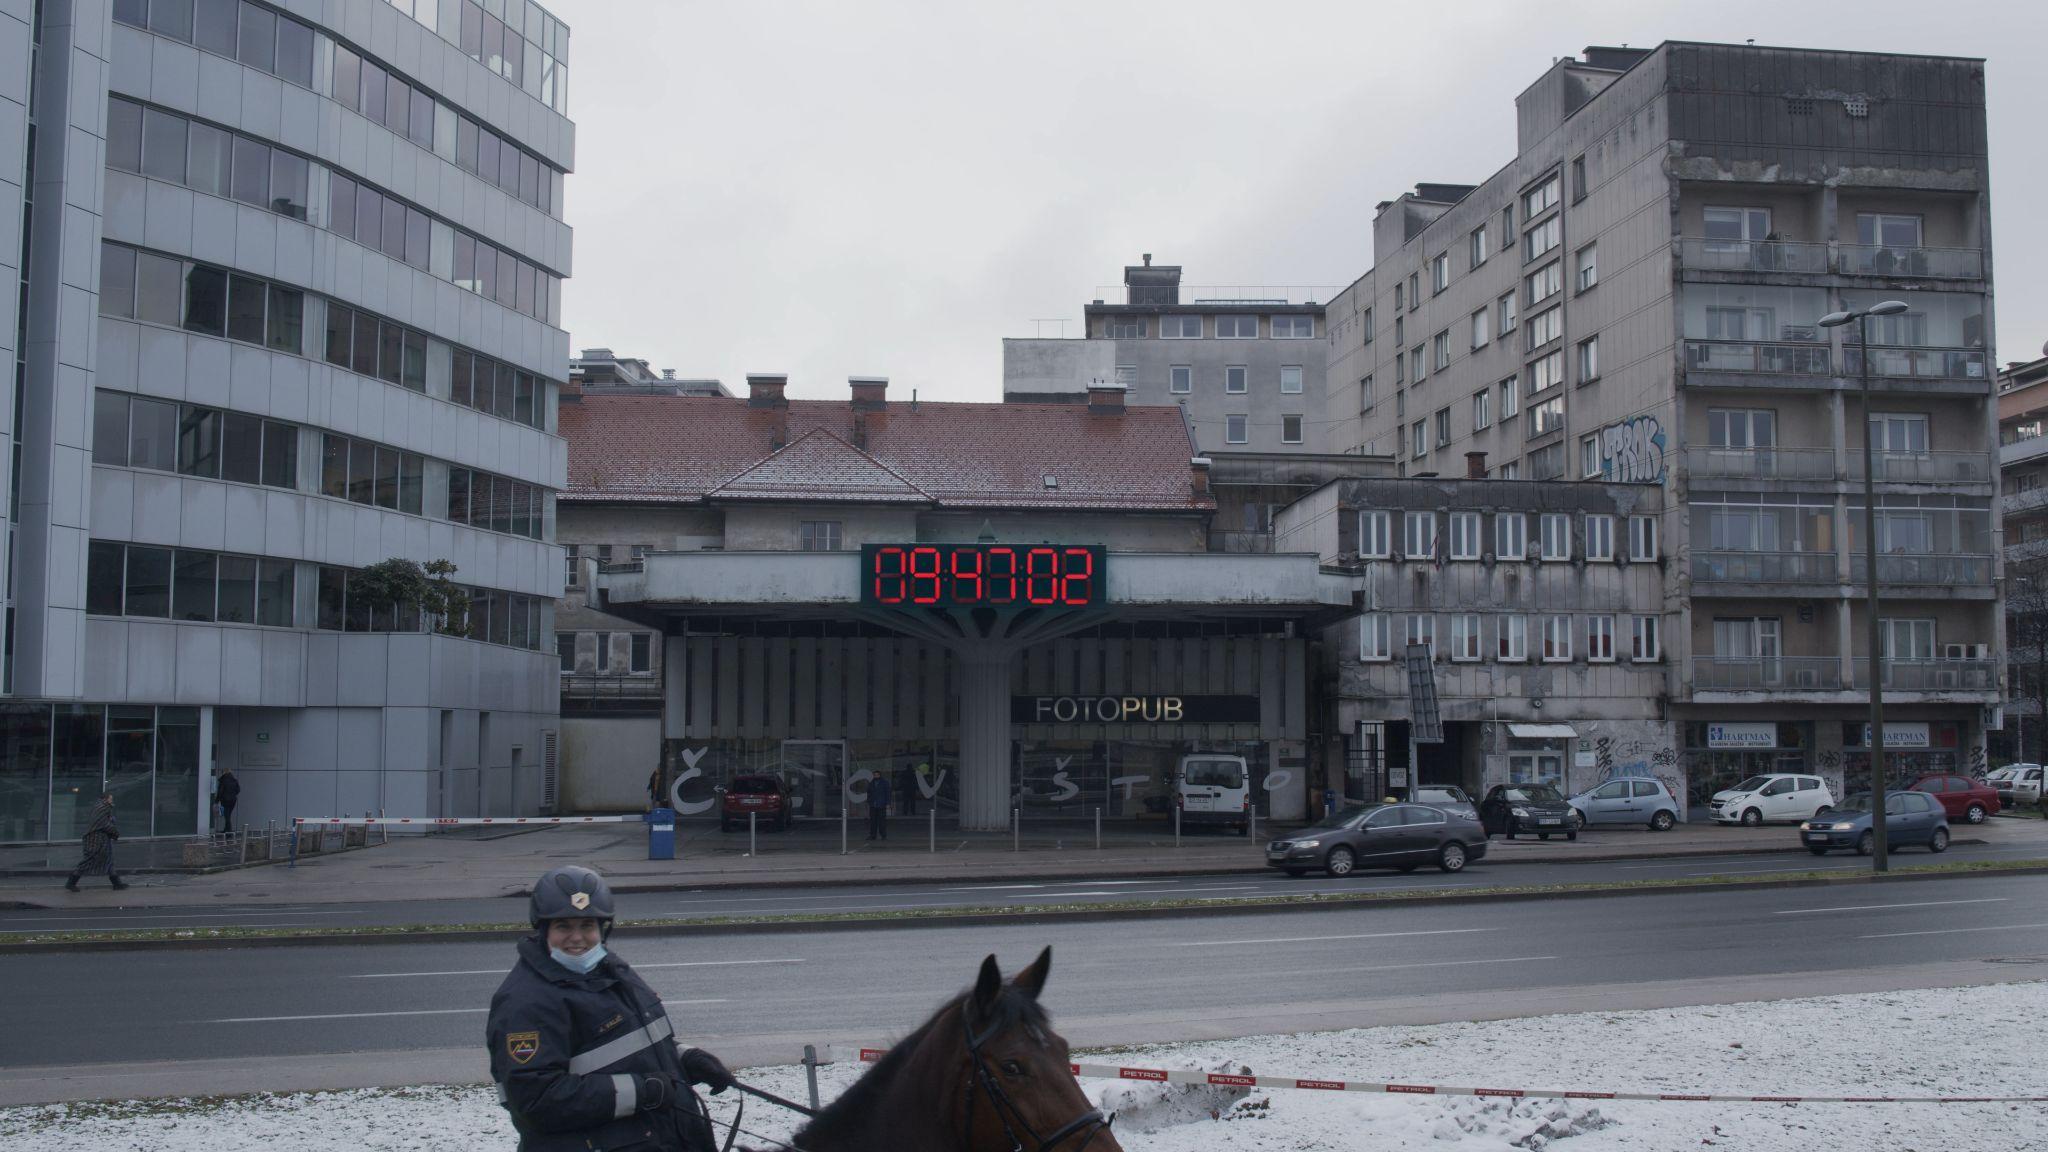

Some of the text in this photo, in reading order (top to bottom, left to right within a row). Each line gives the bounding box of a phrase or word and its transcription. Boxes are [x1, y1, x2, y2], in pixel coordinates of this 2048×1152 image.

[875, 548, 1093, 605] 09:47:02
[1035, 697, 1184, 721] FOTOPUB
[1723, 733, 1771, 741] HARTMAN
[1123, 1070, 1165, 1079] PETROL
[1211, 1076, 1253, 1084] PETROL
